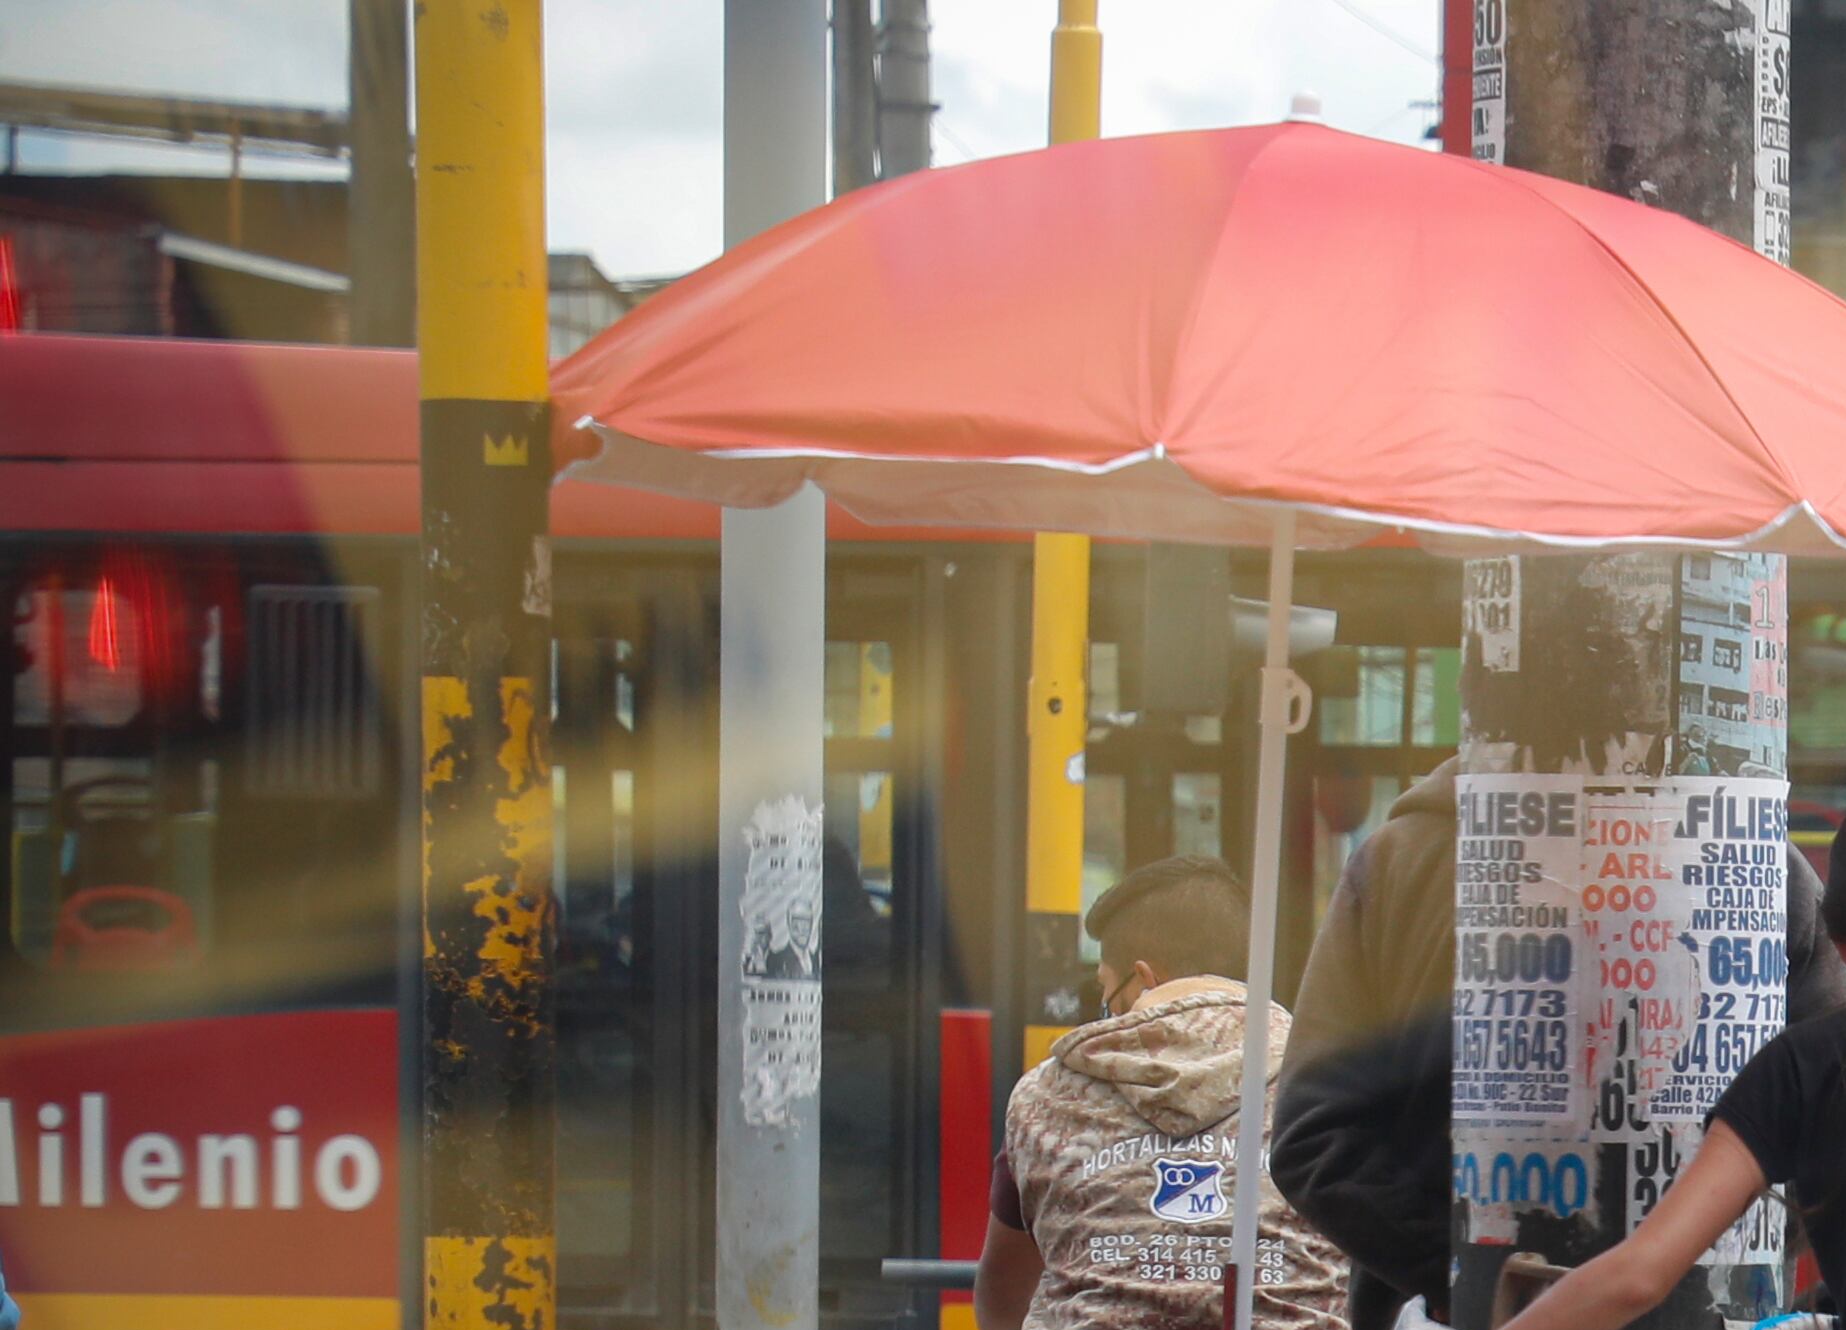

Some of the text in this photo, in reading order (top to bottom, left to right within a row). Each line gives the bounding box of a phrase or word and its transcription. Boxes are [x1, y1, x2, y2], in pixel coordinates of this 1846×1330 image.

[1674, 786, 1787, 842] FÍLIES
[1701, 843, 1776, 866] SALUD
[1682, 865, 1782, 888] RIESGOS
[1496, 884, 1521, 905] DE
[1706, 887, 1774, 910] CAJA DE
[1481, 989, 1566, 1018] 7173
[1497, 1019, 1567, 1071] 5643
[1519, 1084, 1537, 1101] 22
[1651, 1105, 1693, 1116] Barrio
[1188, 1194, 1215, 1213] M
[1090, 1235, 1285, 1251] BOD. 26 PTO 24
[1138, 1248, 1173, 1262] 314
[1180, 1249, 1216, 1263] 415
[1140, 1265, 1284, 1284] 321 330 63
